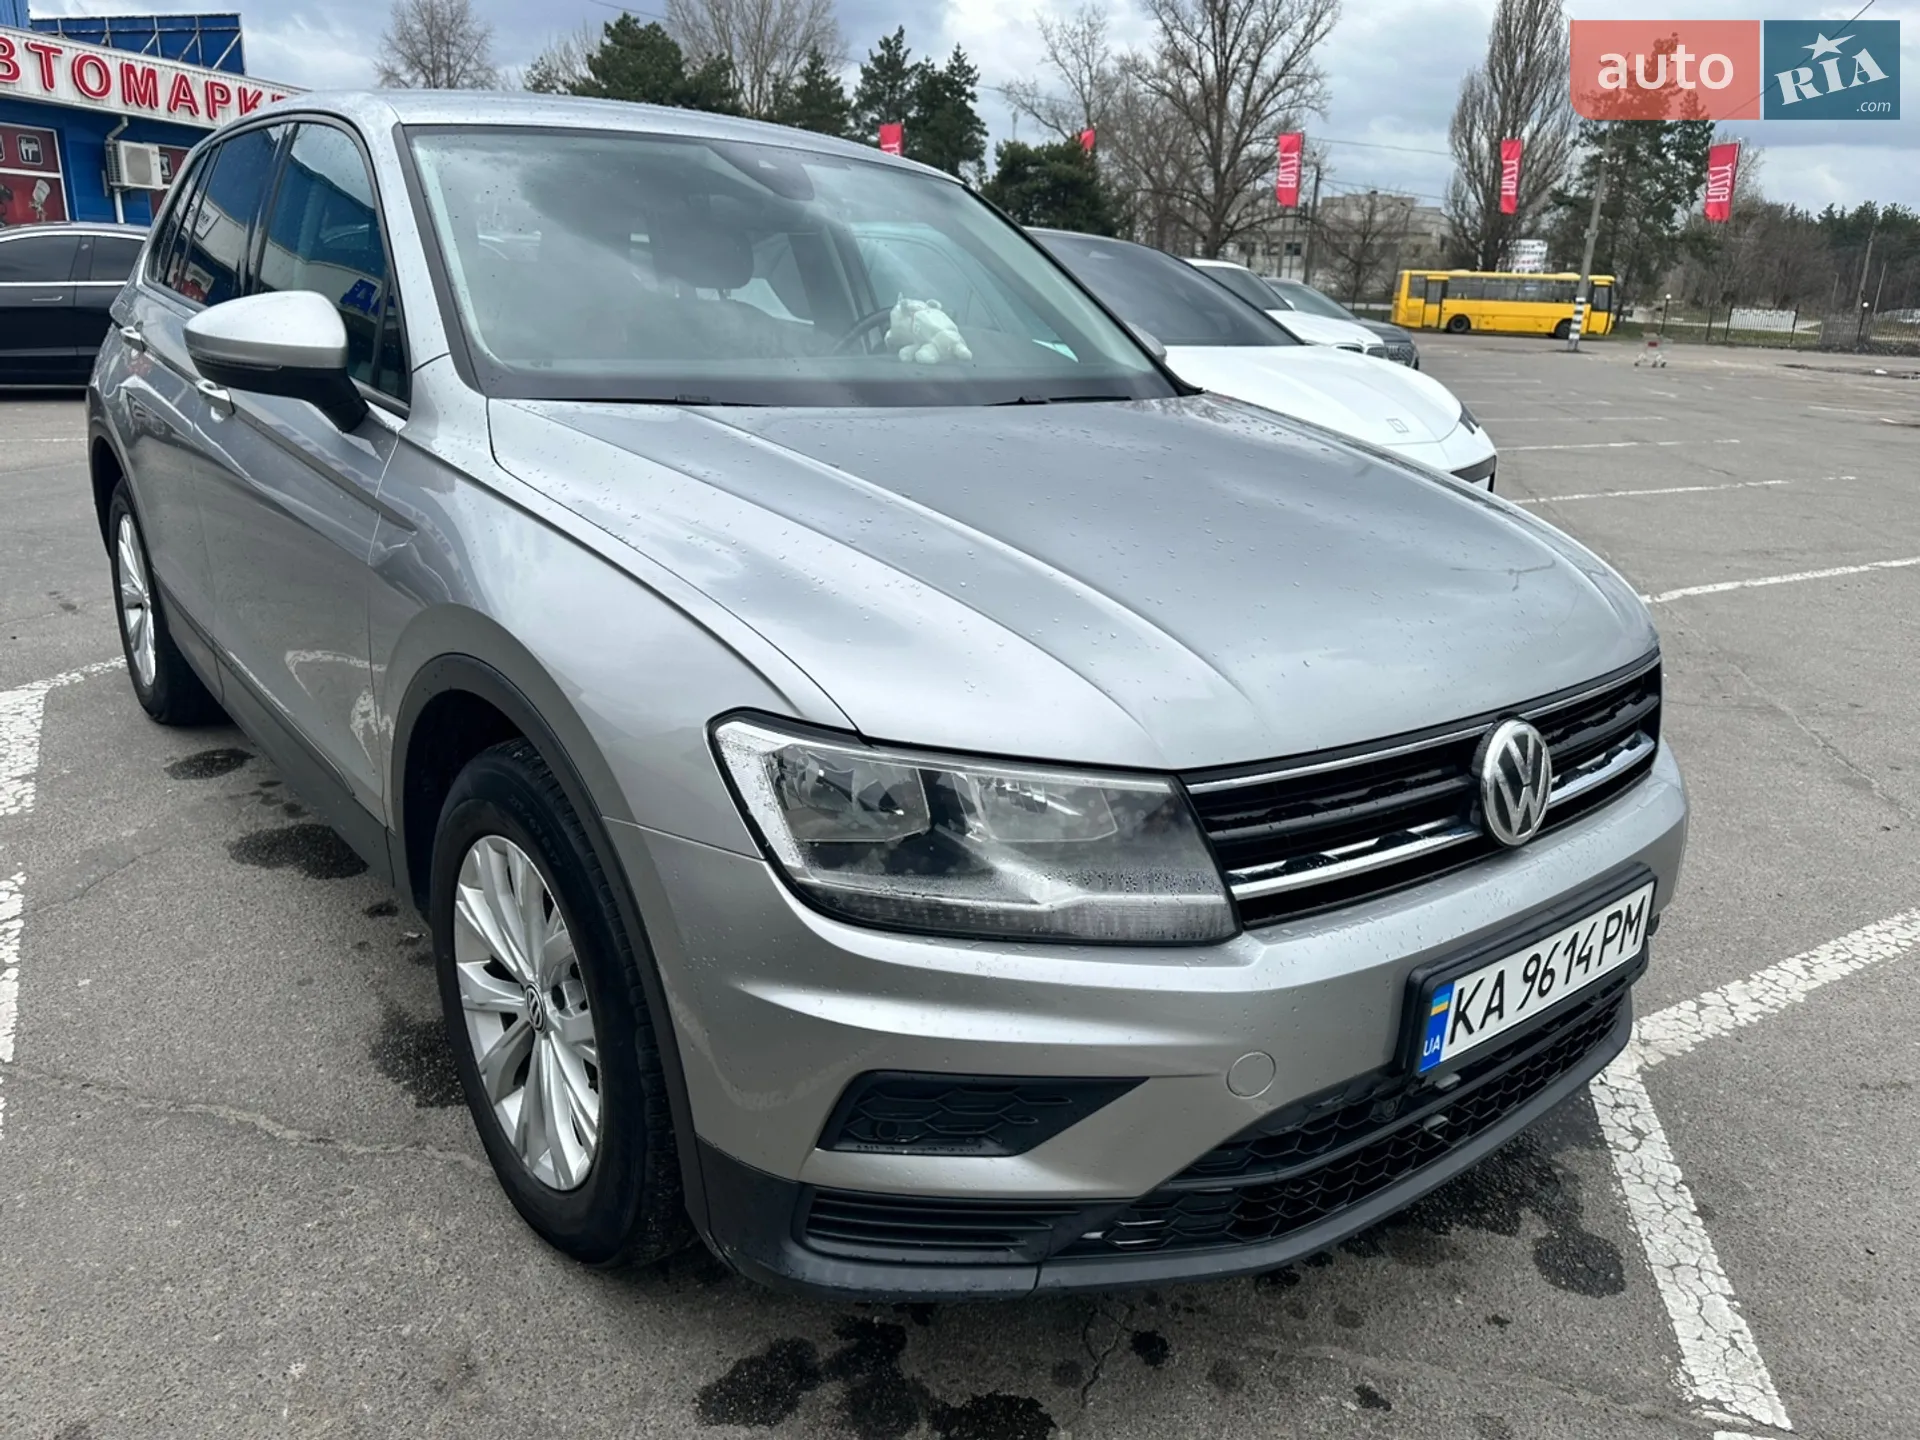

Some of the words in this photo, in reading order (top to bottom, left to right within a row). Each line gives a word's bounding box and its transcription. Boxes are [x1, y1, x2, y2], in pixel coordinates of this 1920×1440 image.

[0, 36, 287, 120] ВТОМАРК
[1423, 1034, 1440, 1057] UA
[1447, 968, 1505, 1046] KA
